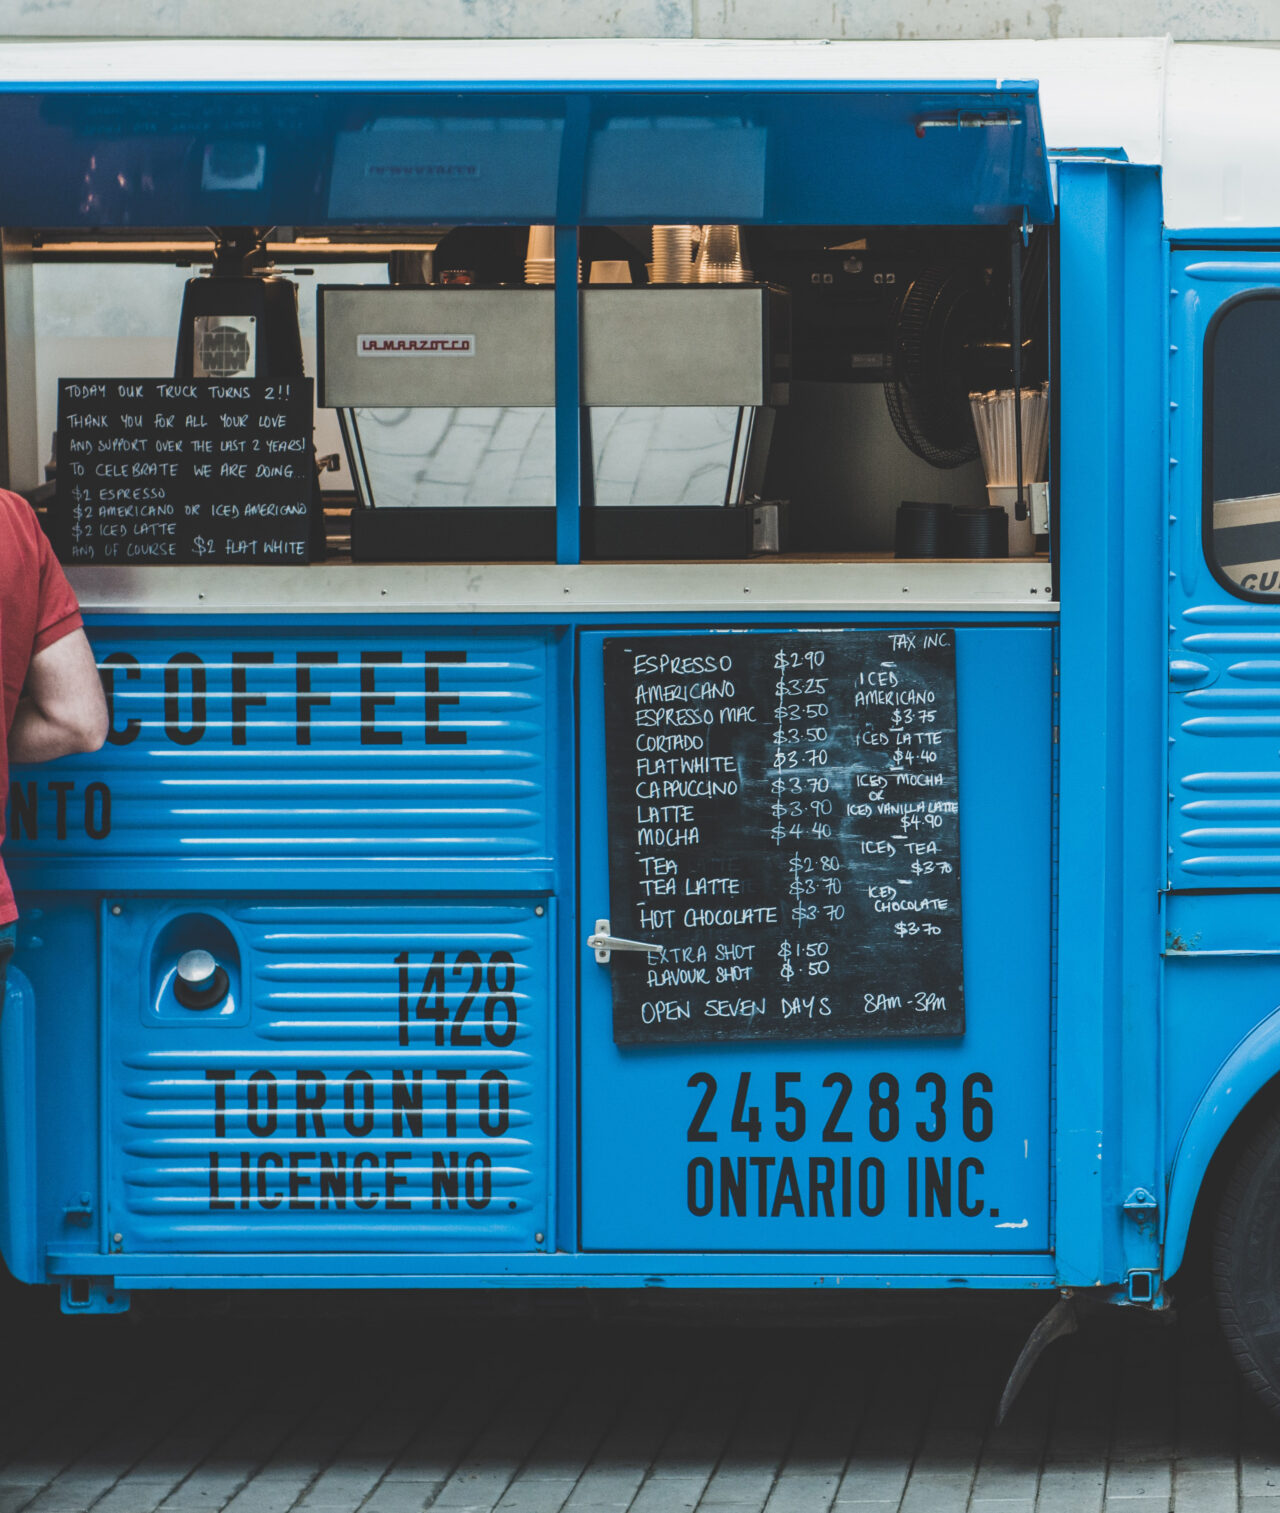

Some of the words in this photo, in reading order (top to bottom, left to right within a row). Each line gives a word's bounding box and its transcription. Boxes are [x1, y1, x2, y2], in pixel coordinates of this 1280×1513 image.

[65, 384, 106, 399] TODAY
[118, 385, 143, 397] OUR
[156, 385, 197, 399] TRUCK
[208, 386, 250, 399] TURNS
[67, 414, 108, 429] THANK
[121, 415, 143, 427] YOU
[186, 415, 207, 427] ALL
[220, 414, 248, 427] YOUR
[259, 415, 286, 427] LOVE
[70, 440, 92, 455] AND
[99, 440, 148, 451] SUPPORT
[156, 441, 182, 452] OVER
[191, 440, 213, 452] THE
[220, 440, 246, 452] LAST
[253, 440, 260, 451] 2
[70, 463, 84, 476] TO
[96, 463, 178, 477] CELEBRATE
[194, 465, 212, 477] WE
[220, 464, 247, 478] ARE
[72, 485, 90, 501] $2
[100, 488, 165, 499] ESPRESSO
[73, 504, 92, 521] $2
[99, 504, 174, 517] AMERICANO
[185, 504, 200, 516] OR
[212, 504, 240, 520] ICED
[245, 502, 307, 517] AMERICANO
[72, 522, 92, 542] $2
[100, 523, 127, 536] ICED
[134, 523, 176, 536] LATTE
[105, 544, 119, 556] OF
[127, 542, 176, 556] COURSE
[192, 535, 215, 556] $2
[225, 539, 258, 554] FLAT
[264, 540, 305, 555] WHITE
[888, 635, 916, 651] TAX
[634, 654, 732, 674] ESPRESSO
[859, 671, 898, 687] ICED
[103, 650, 467, 745] COFFEE
[635, 680, 735, 704] AMERICANO
[855, 689, 935, 707] AMERICANO
[635, 708, 713, 727] ESPRESSO
[720, 706, 757, 724] MAC
[636, 734, 703, 752] CORTADO
[856, 731, 889, 746] ICED
[897, 731, 942, 745] LATTE
[635, 780, 738, 798] CAPPUCCINO
[857, 775, 887, 788] ICED
[897, 774, 943, 786] MOCHA
[638, 805, 694, 823] LATTE
[847, 805, 872, 817] ICED
[877, 801, 925, 814] VANILLA
[929, 801, 958, 813] LATTE
[638, 827, 699, 846] MOCHA
[861, 842, 896, 857] ICED
[904, 841, 942, 855] TEA
[639, 857, 678, 875] TEA
[639, 878, 676, 896] TEA
[686, 878, 739, 896] LATTE
[868, 885, 897, 900] ICED
[875, 899, 948, 912] CHOCOLATE
[640, 909, 675, 930] HOT
[684, 907, 778, 927] CHOCOLATE
[647, 945, 707, 965] EXTRA
[715, 944, 755, 961] SHOT
[647, 968, 710, 987] FLAVOUR
[716, 966, 752, 983] SHOT
[394, 950, 517, 1048] 1428
[641, 1000, 691, 1024] OPEN
[704, 998, 765, 1017] SEVEN
[782, 996, 831, 1019] DAYS
[206, 1069, 510, 1138] TORONTO
[687, 1072, 993, 1142] 2452836
[209, 1151, 412, 1210] LICENCE
[687, 1157, 885, 1217] ONTARIO
[908, 1157, 999, 1217] INC.
